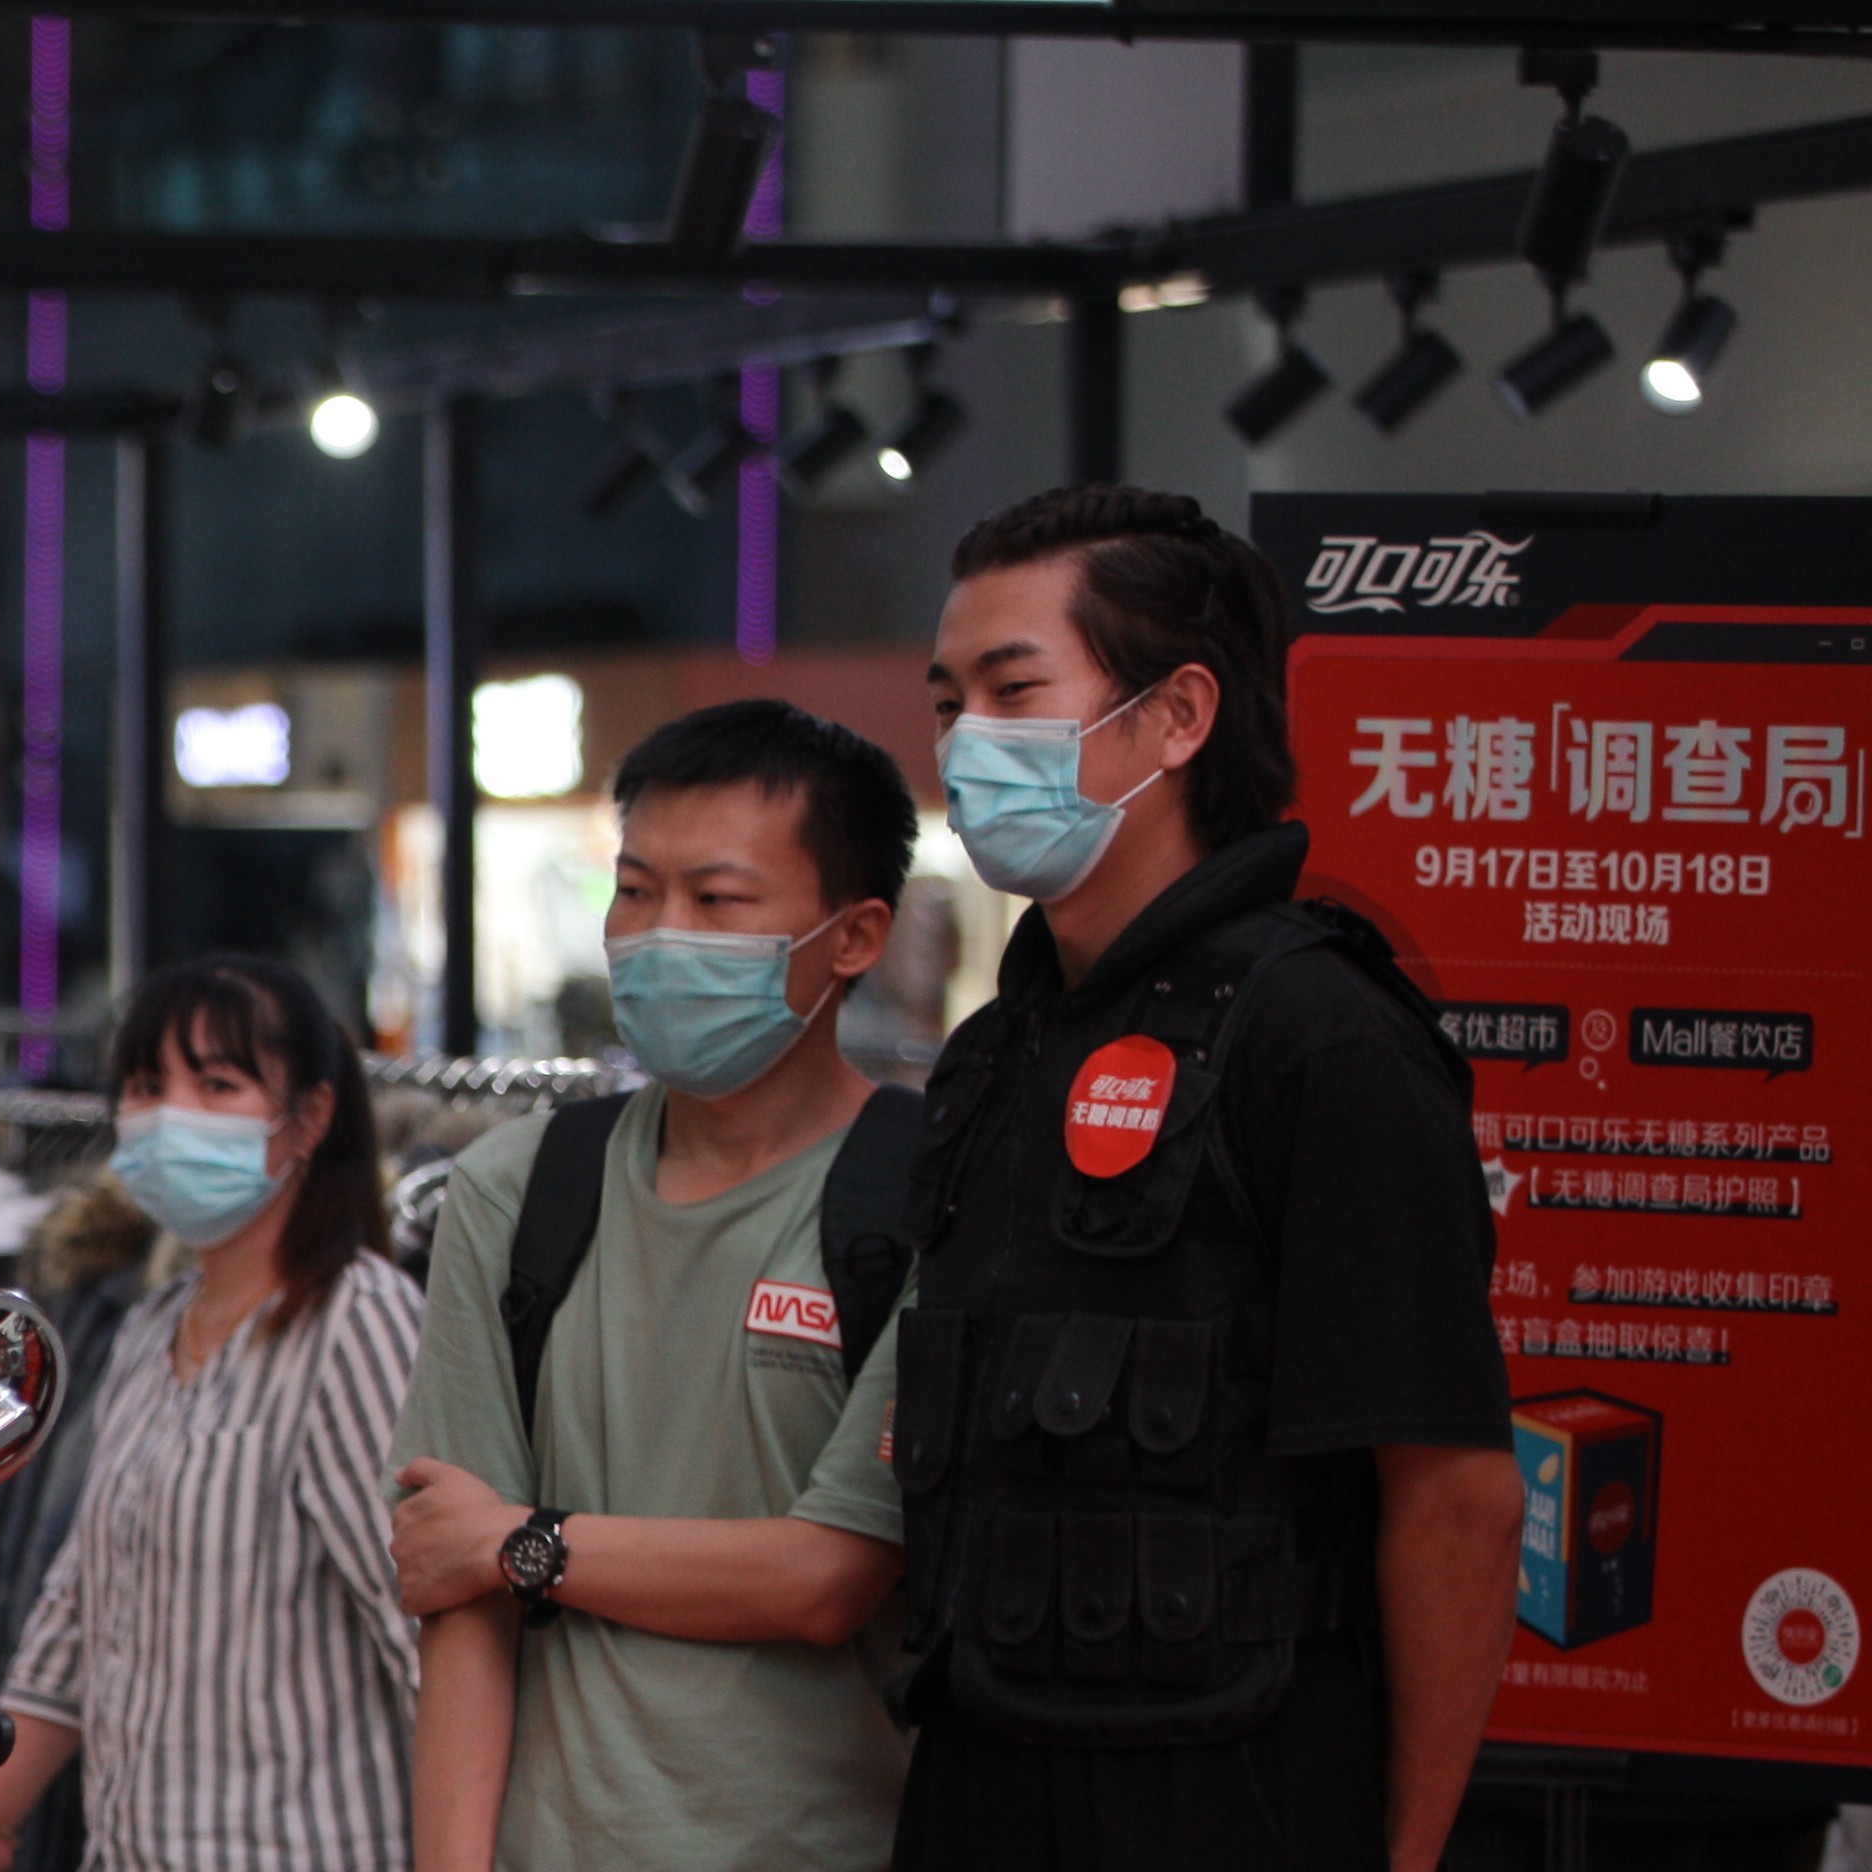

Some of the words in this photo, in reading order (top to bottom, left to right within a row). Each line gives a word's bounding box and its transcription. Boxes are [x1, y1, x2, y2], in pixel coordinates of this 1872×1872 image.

[1305, 531, 1535, 614] 可口可乐
[1415, 846, 1771, 895] 9月17日至10月18日
[1523, 902, 1670, 945] 活动现场
[1642, 1019, 1804, 1062] Mall餐饮店
